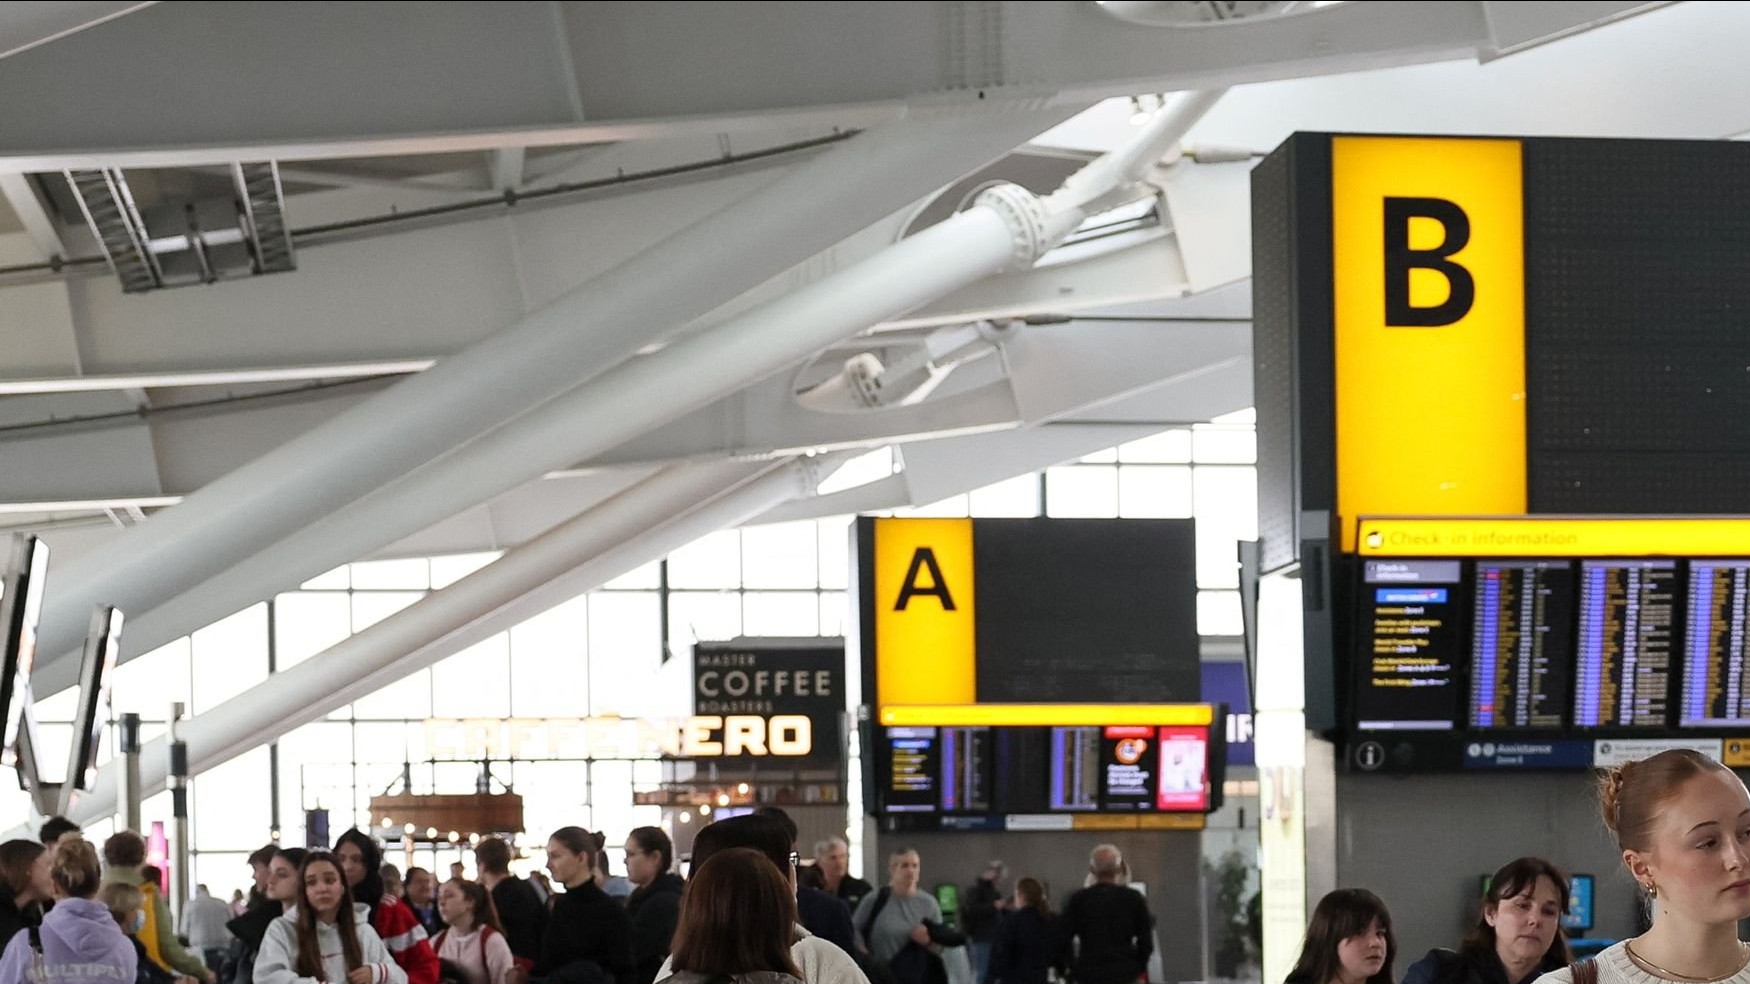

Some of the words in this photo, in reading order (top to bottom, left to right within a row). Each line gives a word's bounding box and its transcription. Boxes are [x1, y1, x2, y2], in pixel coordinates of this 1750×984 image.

[1383, 196, 1475, 327] B
[1472, 530, 1579, 546] information
[893, 547, 957, 611] A
[699, 670, 832, 697] COFFEE
[637, 715, 812, 757] NERO
